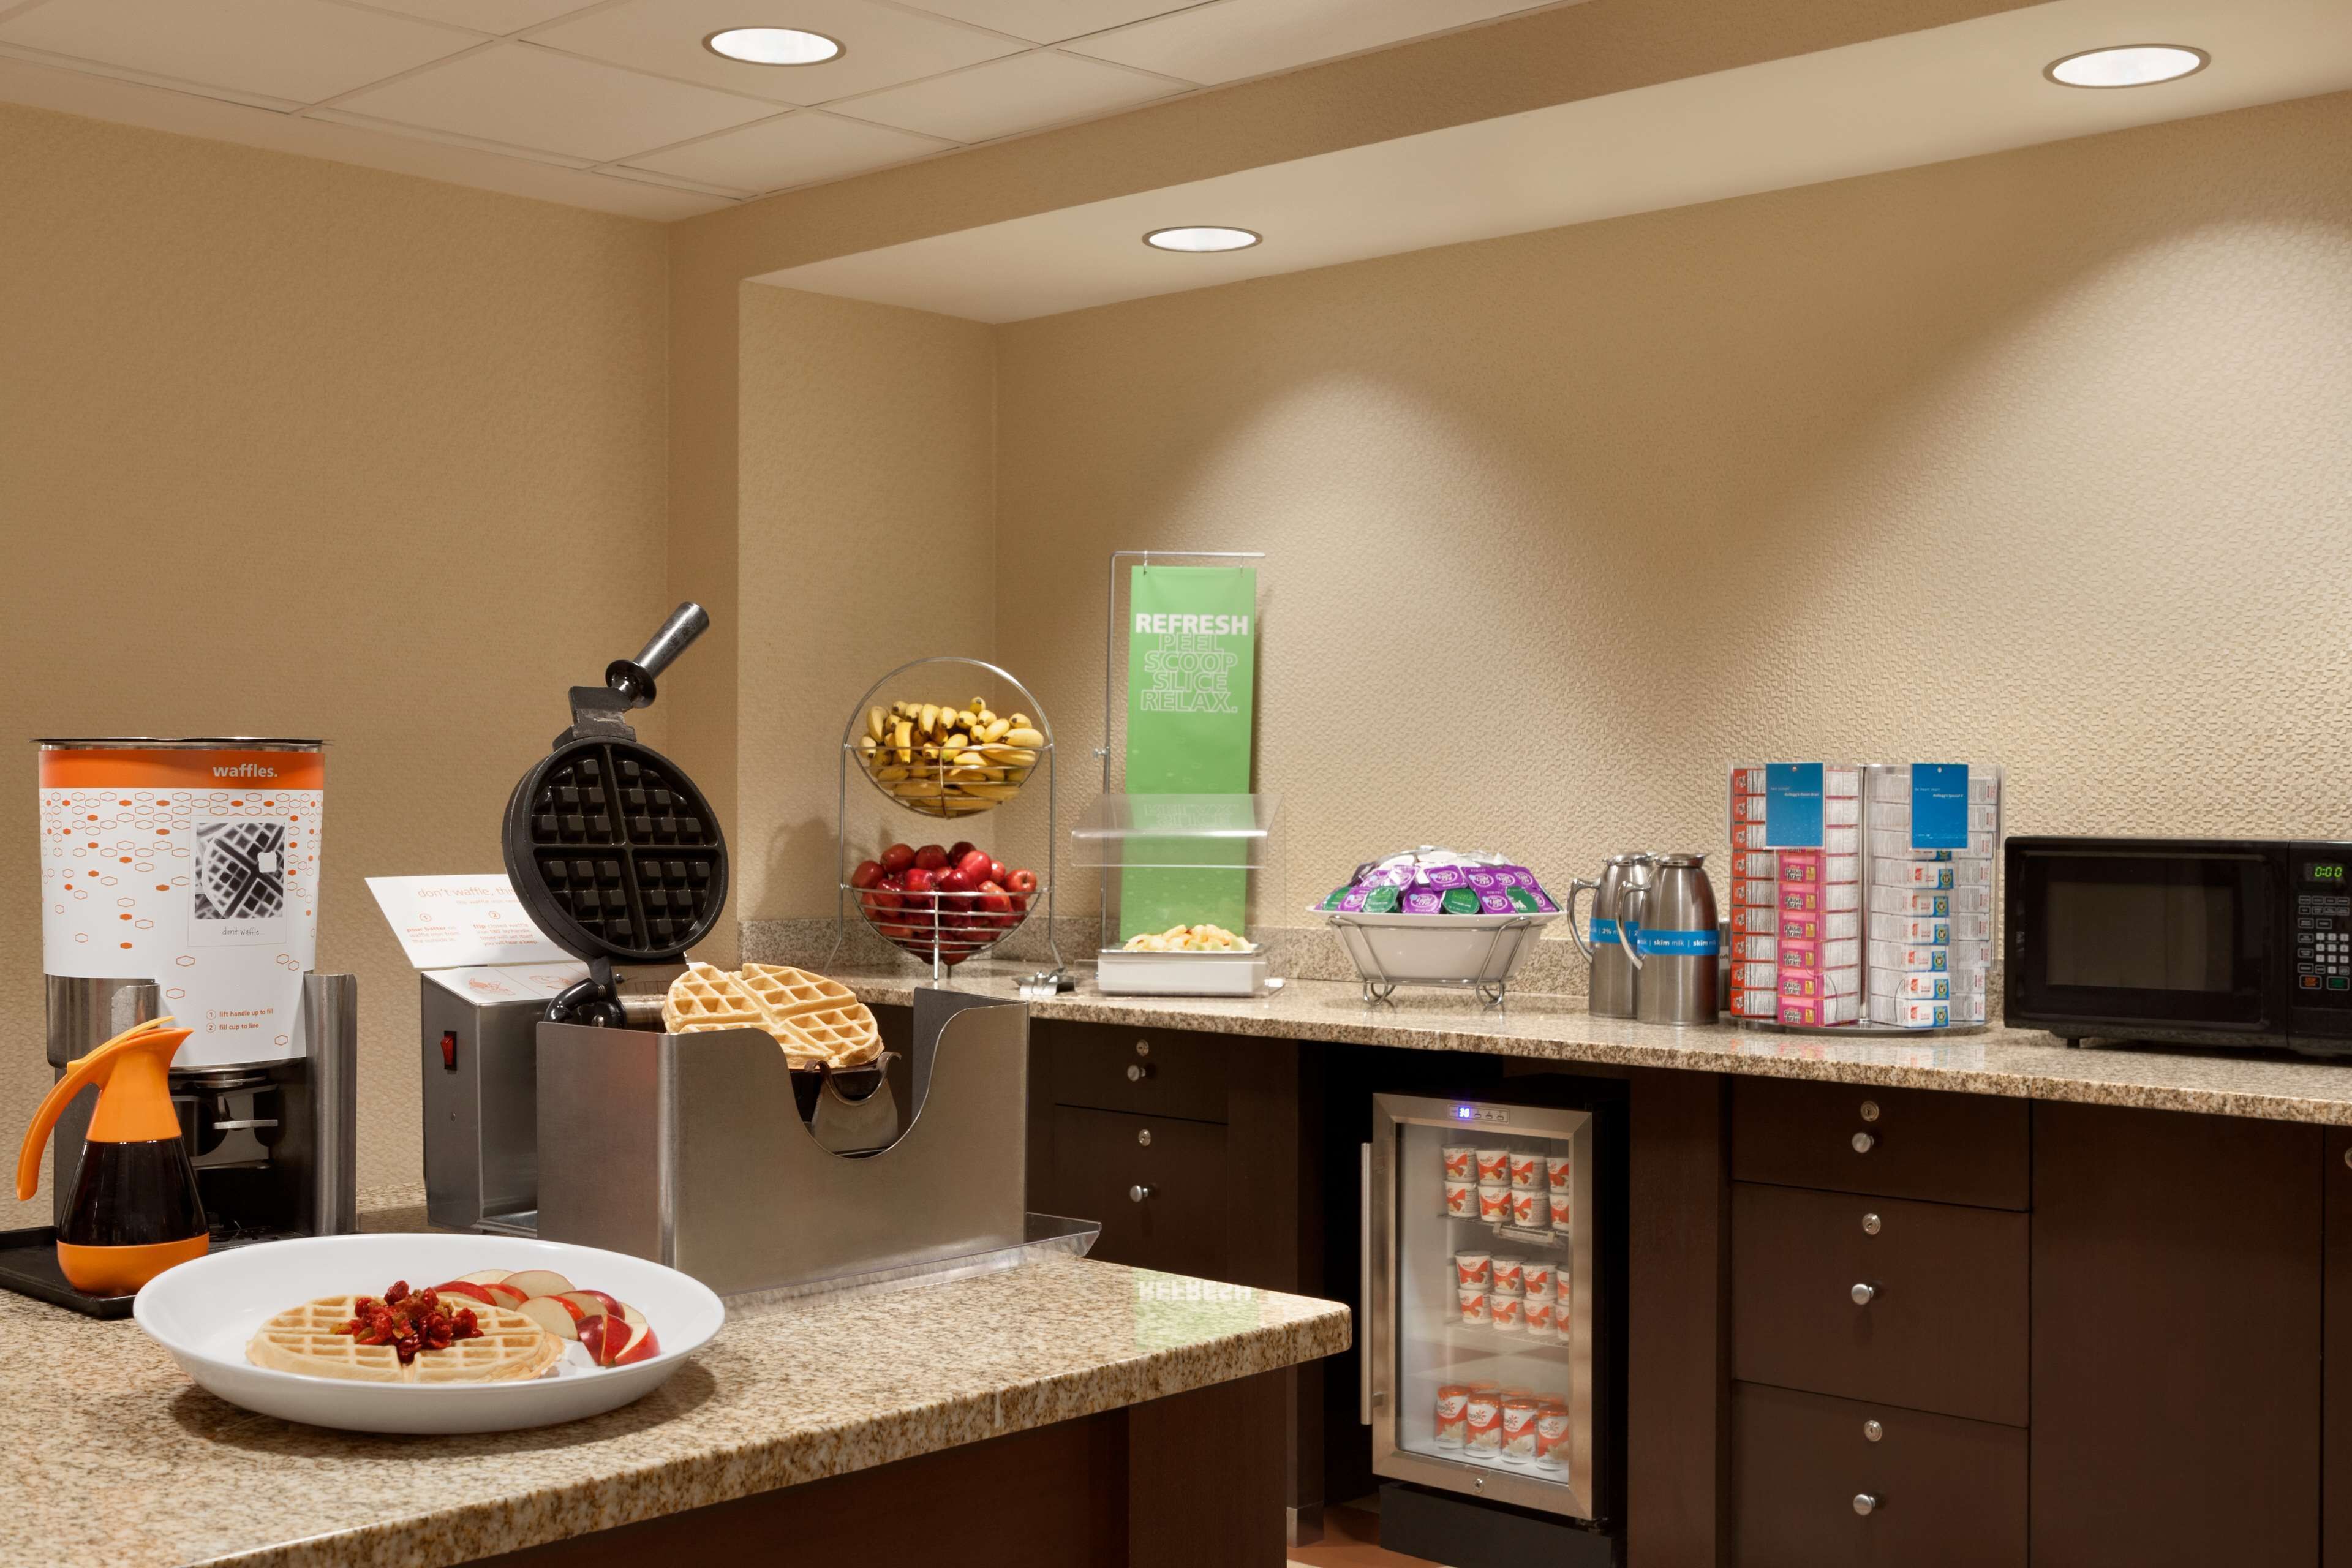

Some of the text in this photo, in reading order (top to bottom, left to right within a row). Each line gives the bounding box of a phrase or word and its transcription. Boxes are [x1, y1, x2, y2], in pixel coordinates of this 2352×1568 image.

[1136, 613, 1249, 636] REFRESH
[1159, 632, 1224, 654] PEEL
[1144, 650, 1238, 674] SCOOP
[1152, 671, 1228, 693] SLICE
[1140, 690, 1238, 713] RELAX.
[213, 763, 278, 777] waffles.
[1785, 867, 1803, 876] Raisin
[2315, 867, 2343, 877] 0:00
[418, 888, 450, 897] don't
[453, 886, 494, 896] waffle,
[1784, 924, 1803, 932] Raisin
[1787, 930, 1802, 939] Bran
